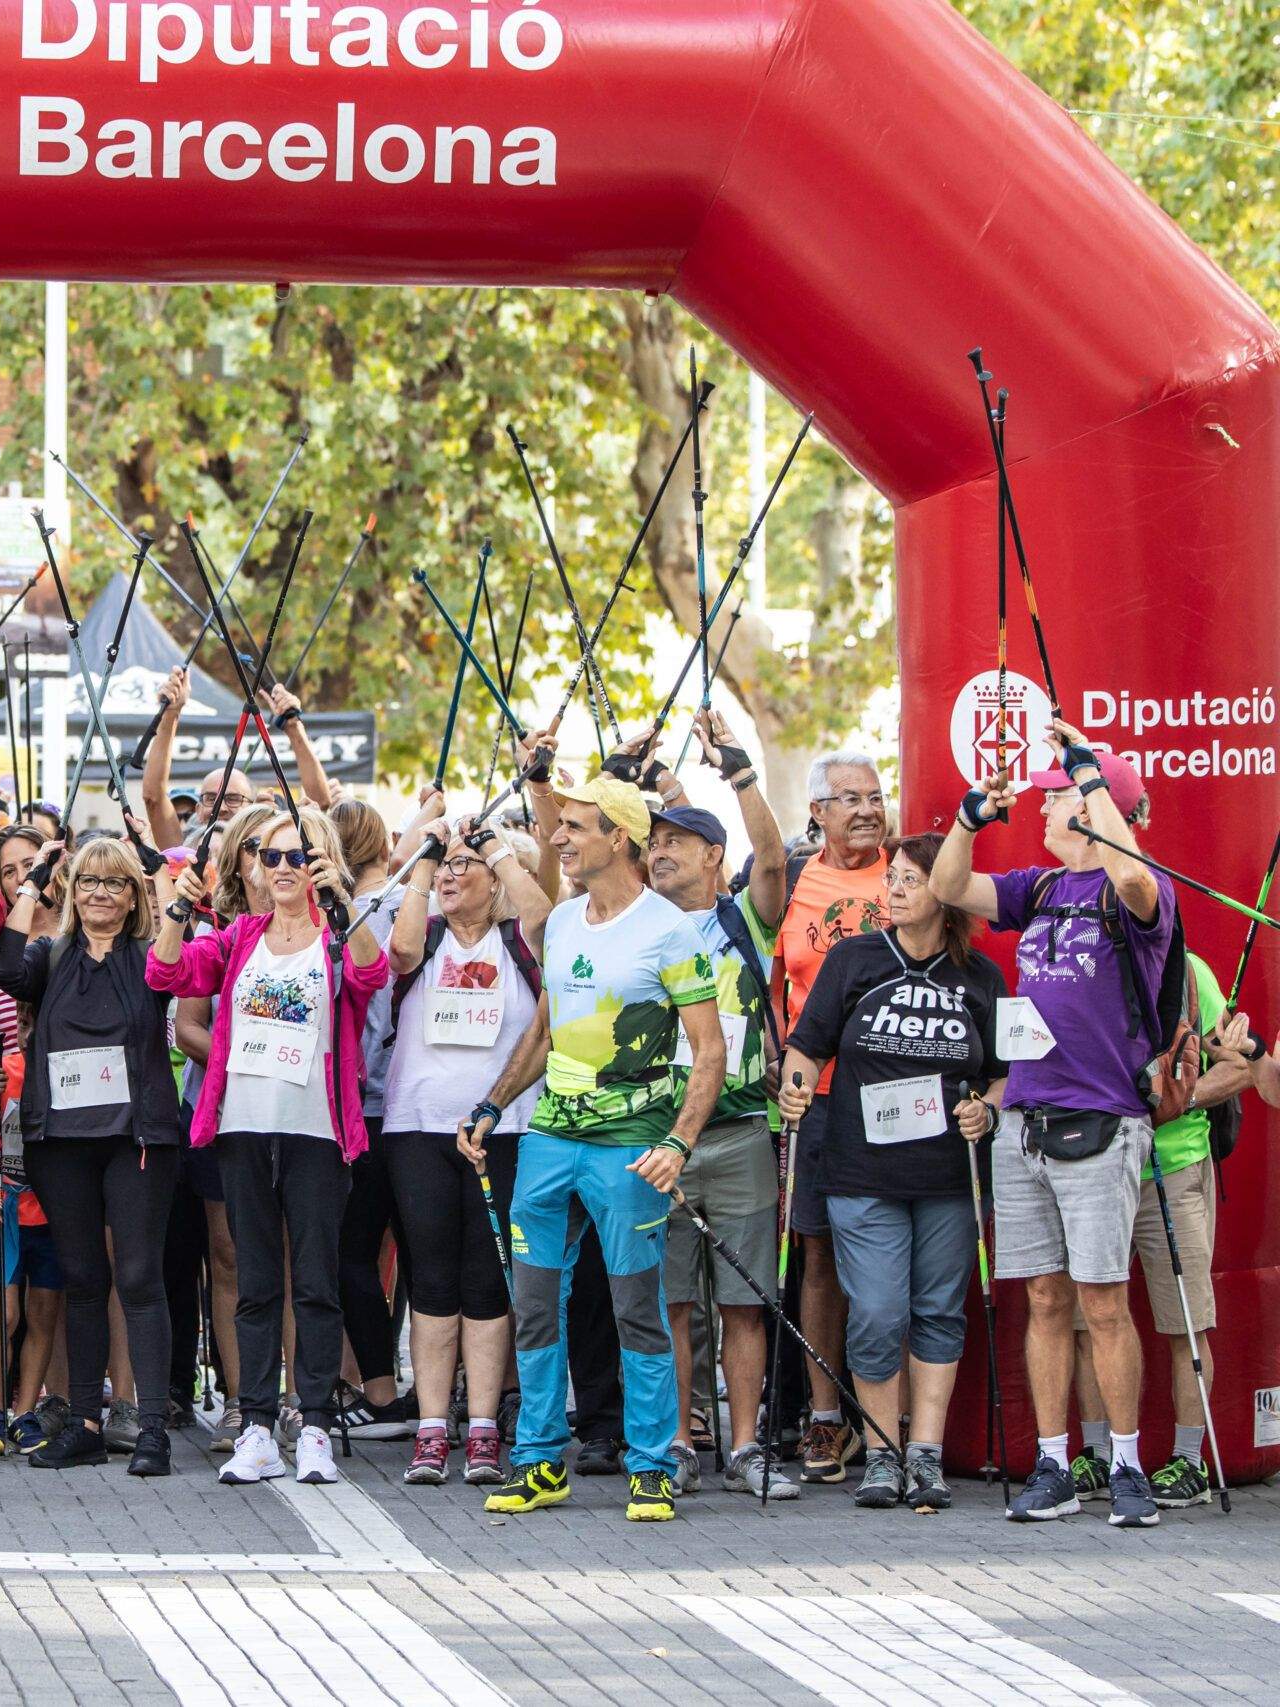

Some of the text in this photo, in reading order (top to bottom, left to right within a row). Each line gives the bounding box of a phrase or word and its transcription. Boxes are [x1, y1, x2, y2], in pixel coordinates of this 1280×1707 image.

[20, 0, 564, 83] Diputació
[19, 96, 558, 186] Barcelona
[1082, 686, 1276, 736] Diputació
[890, 984, 966, 1012] anti
[465, 1008, 499, 1025] 145
[861, 1005, 967, 1040] -hero
[277, 1045, 302, 1065] 55
[100, 1066, 112, 1083] 4
[914, 1097, 938, 1117] 54
